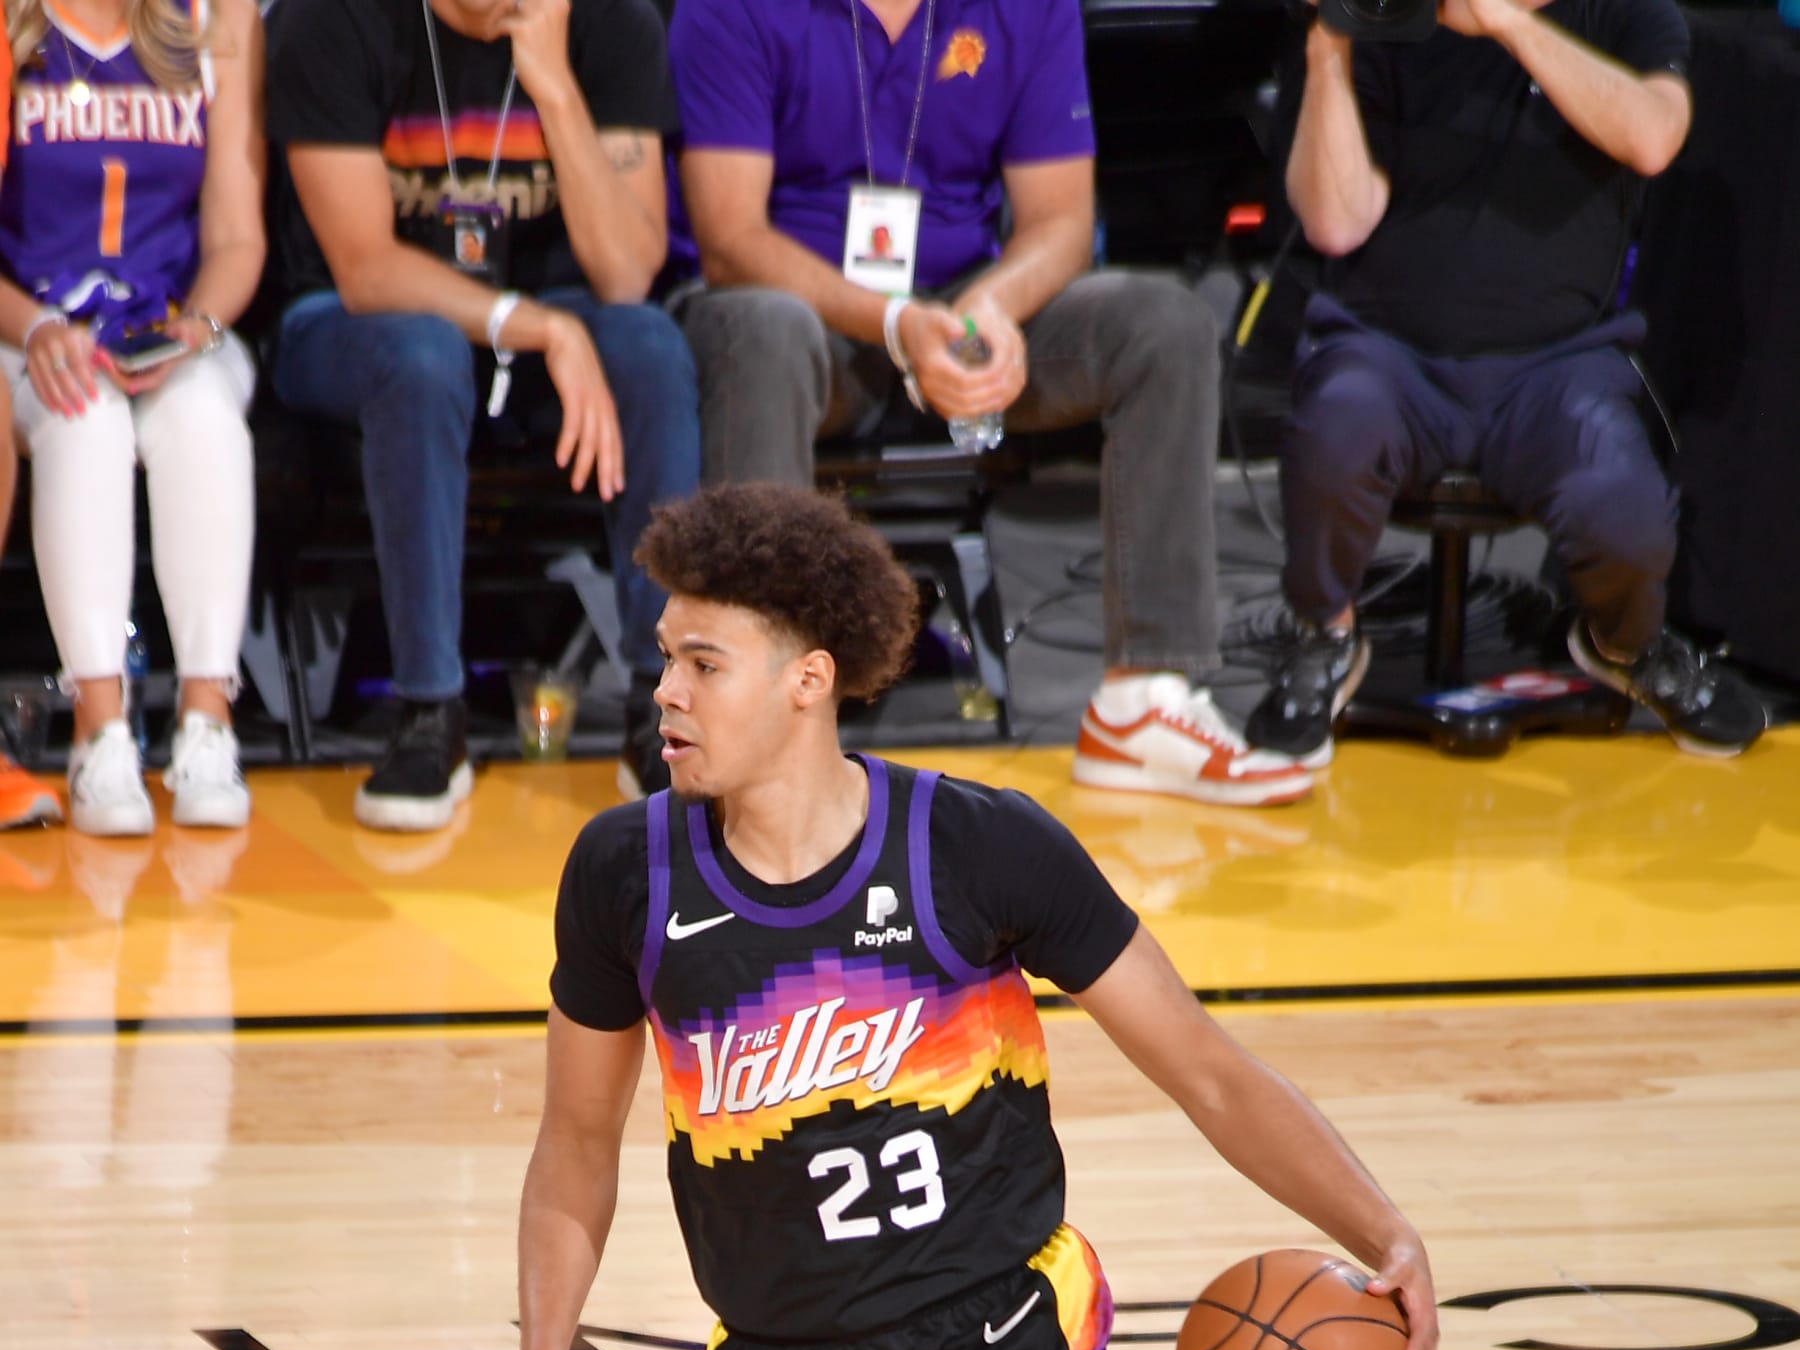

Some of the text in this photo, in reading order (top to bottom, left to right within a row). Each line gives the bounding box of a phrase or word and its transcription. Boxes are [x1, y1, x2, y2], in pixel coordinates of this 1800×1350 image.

[15, 83, 206, 148] PHOENIX
[99, 159, 127, 258] 1
[854, 925, 913, 947] PayPal
[688, 996, 925, 1115] Valley
[738, 1023, 782, 1054] THE
[807, 1129, 947, 1241] 23
